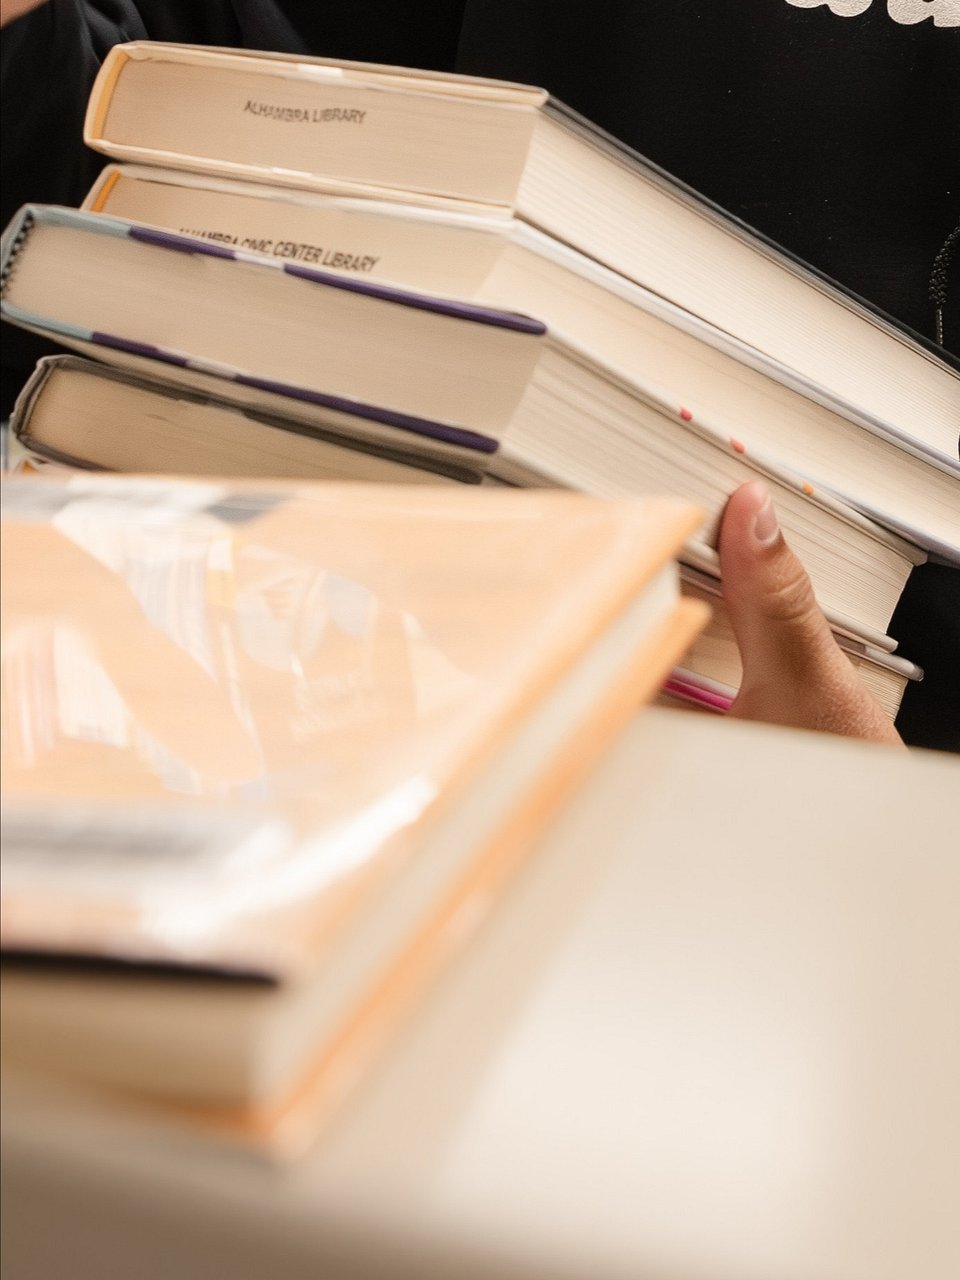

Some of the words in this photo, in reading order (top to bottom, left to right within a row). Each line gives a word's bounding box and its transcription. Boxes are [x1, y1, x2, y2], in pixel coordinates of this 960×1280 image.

[244, 100, 309, 122] ALHAMBRA
[312, 107, 367, 124] LIBRARY
[273, 241, 324, 264] CENTER
[322, 249, 381, 272] LIBRARY
